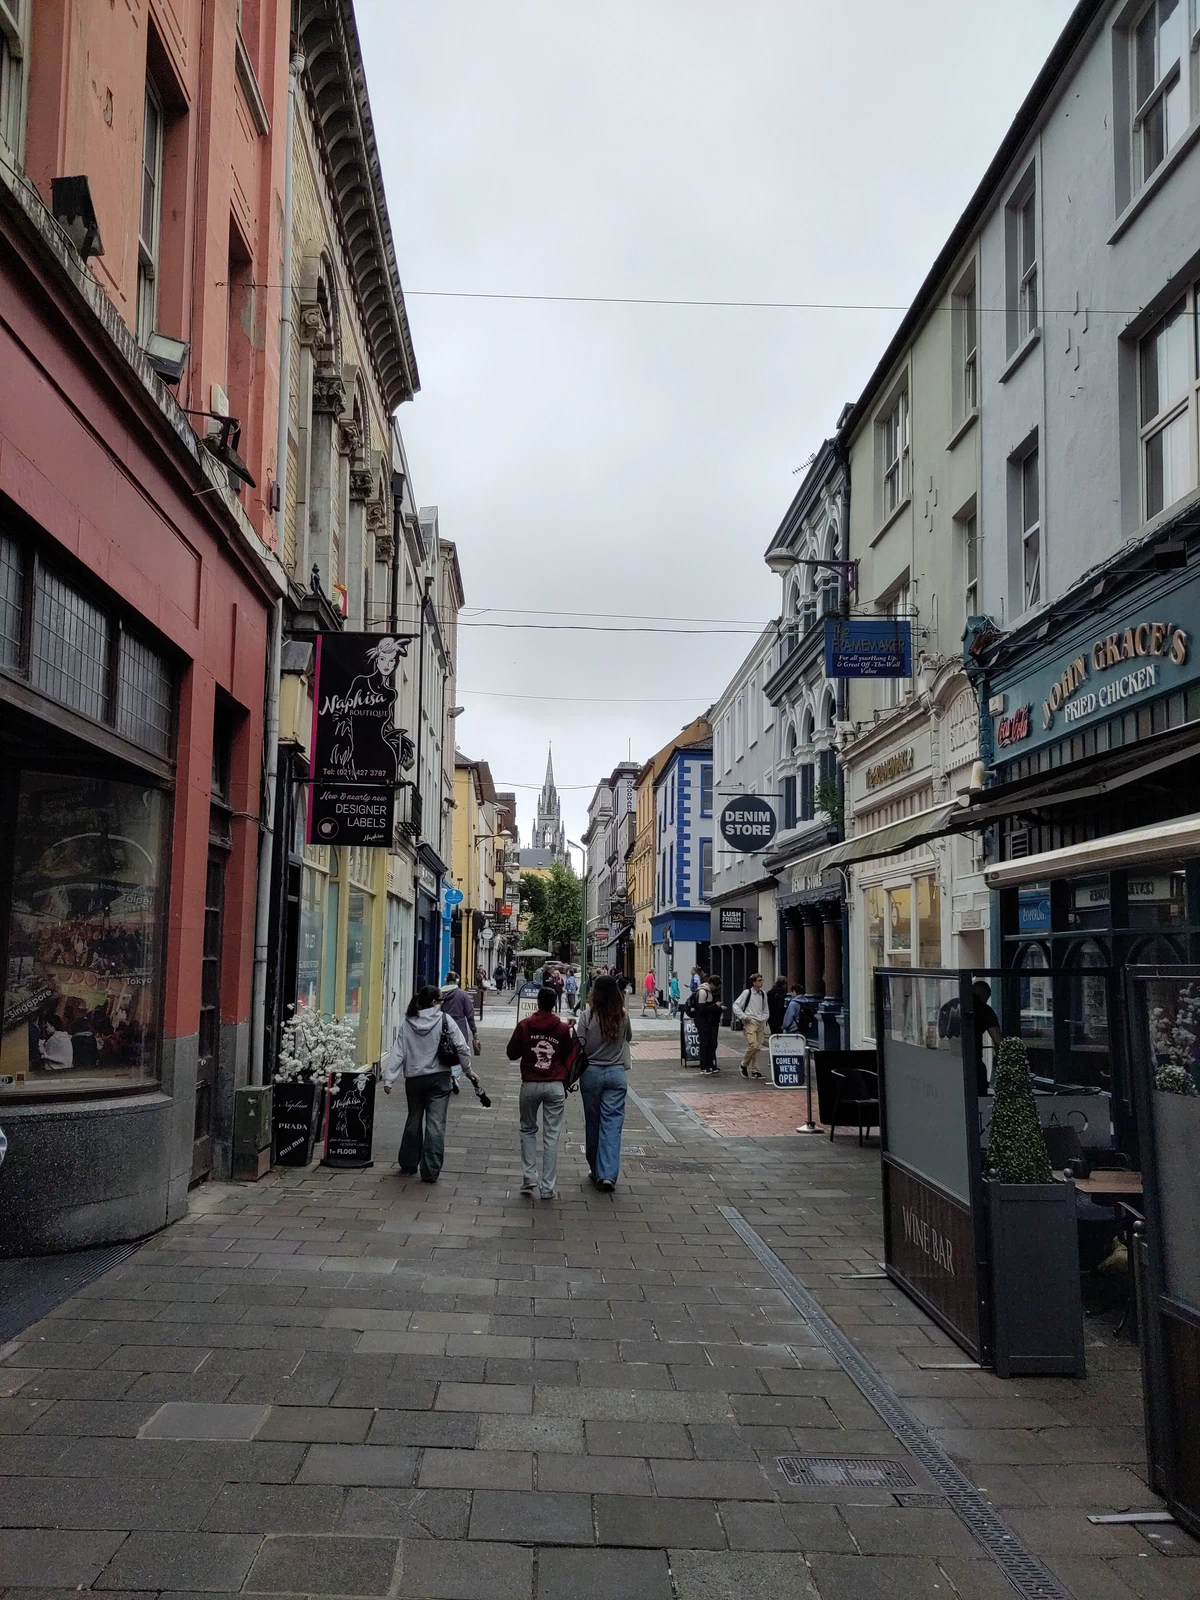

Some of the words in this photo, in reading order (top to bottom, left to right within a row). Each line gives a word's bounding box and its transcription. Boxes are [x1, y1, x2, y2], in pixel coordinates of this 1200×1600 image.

[832, 639, 905, 652] FRAMEMAKER
[1042, 653, 1089, 730] JOHN
[1091, 622, 1188, 670] GRACE'S
[1064, 693, 1098, 723] FRIED
[1098, 664, 1156, 708] CHICKEN
[319, 689, 388, 716] Naphisa
[349, 709, 389, 718] BOUTIQUE
[356, 769, 368, 777] 427
[320, 791, 338, 800] New
[346, 793, 371, 803] nearly
[335, 803, 387, 815] DESIGNER
[347, 817, 387, 828] LABELS
[725, 811, 771, 823] DENIM
[725, 824, 771, 836] STORE
[123, 894, 153, 908] Taipei
[126, 976, 153, 987] Tokyo
[8, 989, 52, 1019] Singapore
[775, 1057, 791, 1065] COME
[791, 1057, 800, 1066] IN,
[778, 1074, 799, 1084] OPEN
[278, 1122, 308, 1131] PRADA
[902, 1205, 930, 1255] WINE
[931, 1227, 955, 1278] BAR
